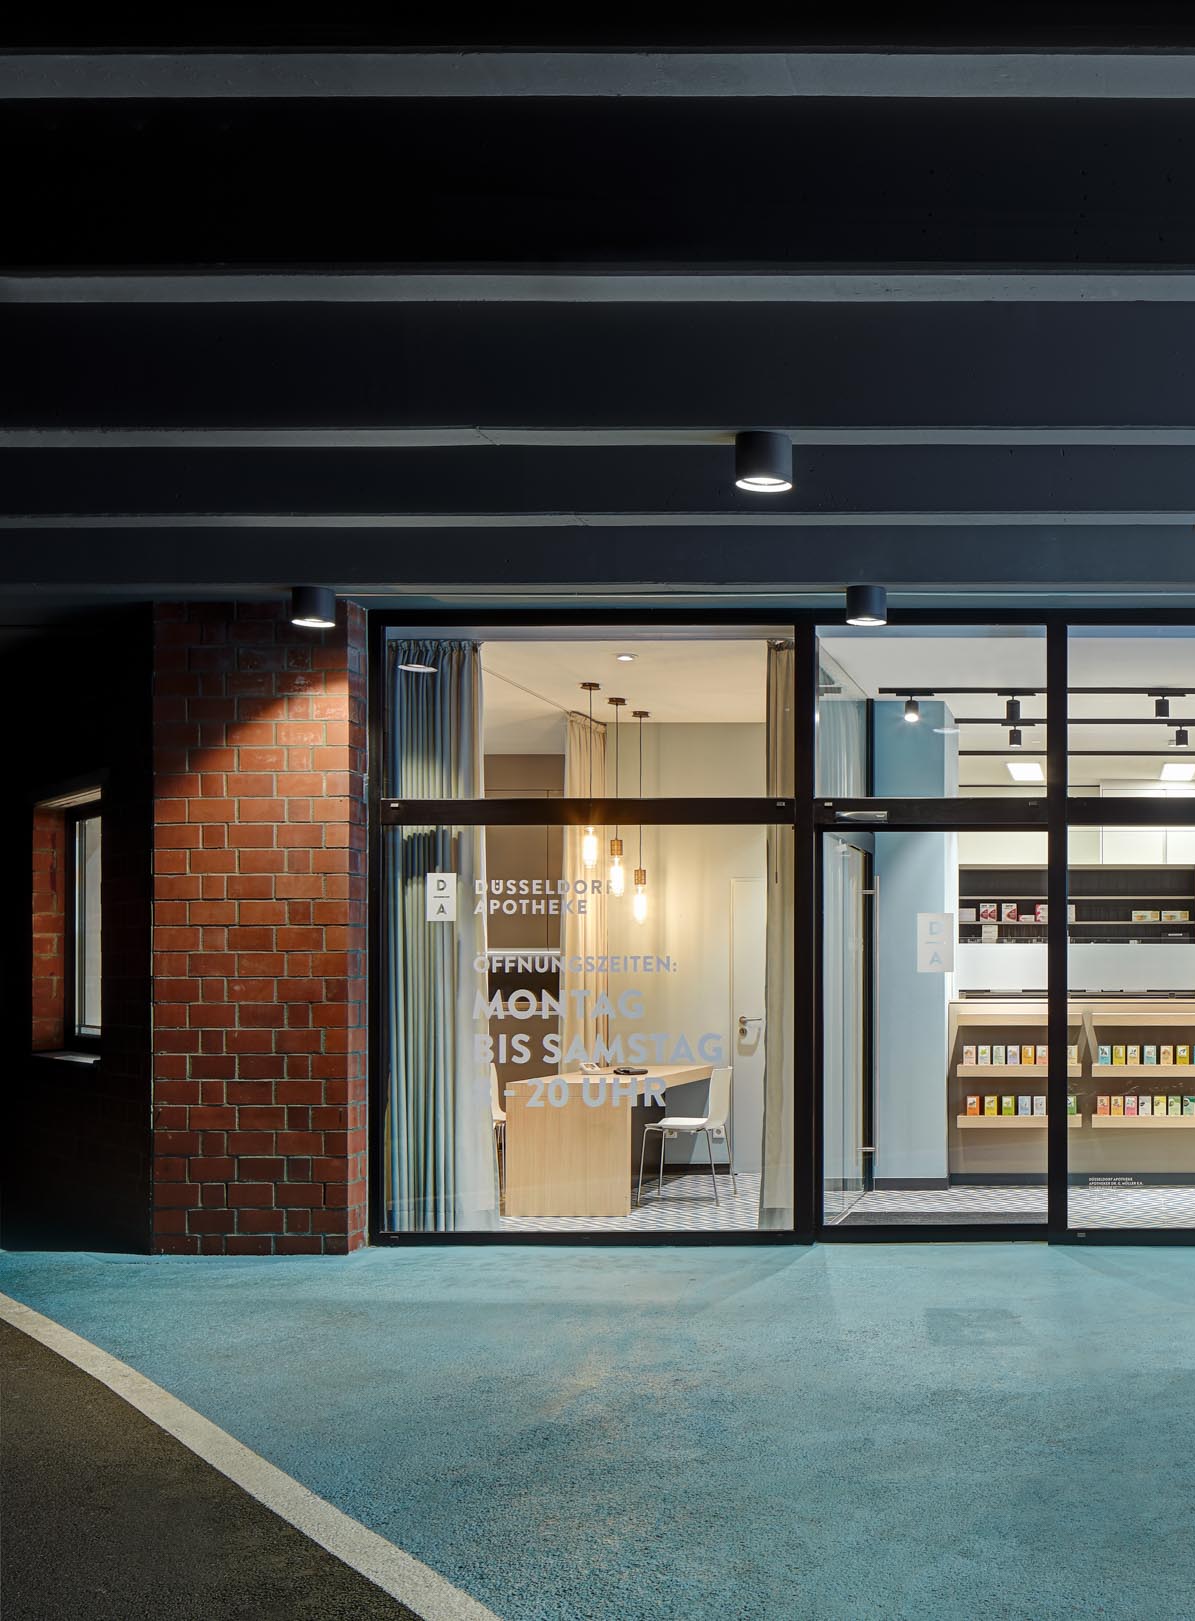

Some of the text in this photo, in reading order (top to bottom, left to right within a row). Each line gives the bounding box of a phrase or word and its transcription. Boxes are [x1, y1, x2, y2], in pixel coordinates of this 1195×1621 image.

[437, 879, 447, 892] D
[436, 903, 447, 915] A
[474, 899, 588, 915] APOTHEKE
[928, 921, 944, 936] D
[472, 952, 678, 973] ÖFFNUNGSZEITEN:
[928, 951, 944, 966] A
[472, 988, 644, 1020] MONTAG
[474, 1033, 723, 1065] BIS SAMSTAG
[525, 1077, 570, 1109] 20
[582, 1077, 667, 1108] UHR
